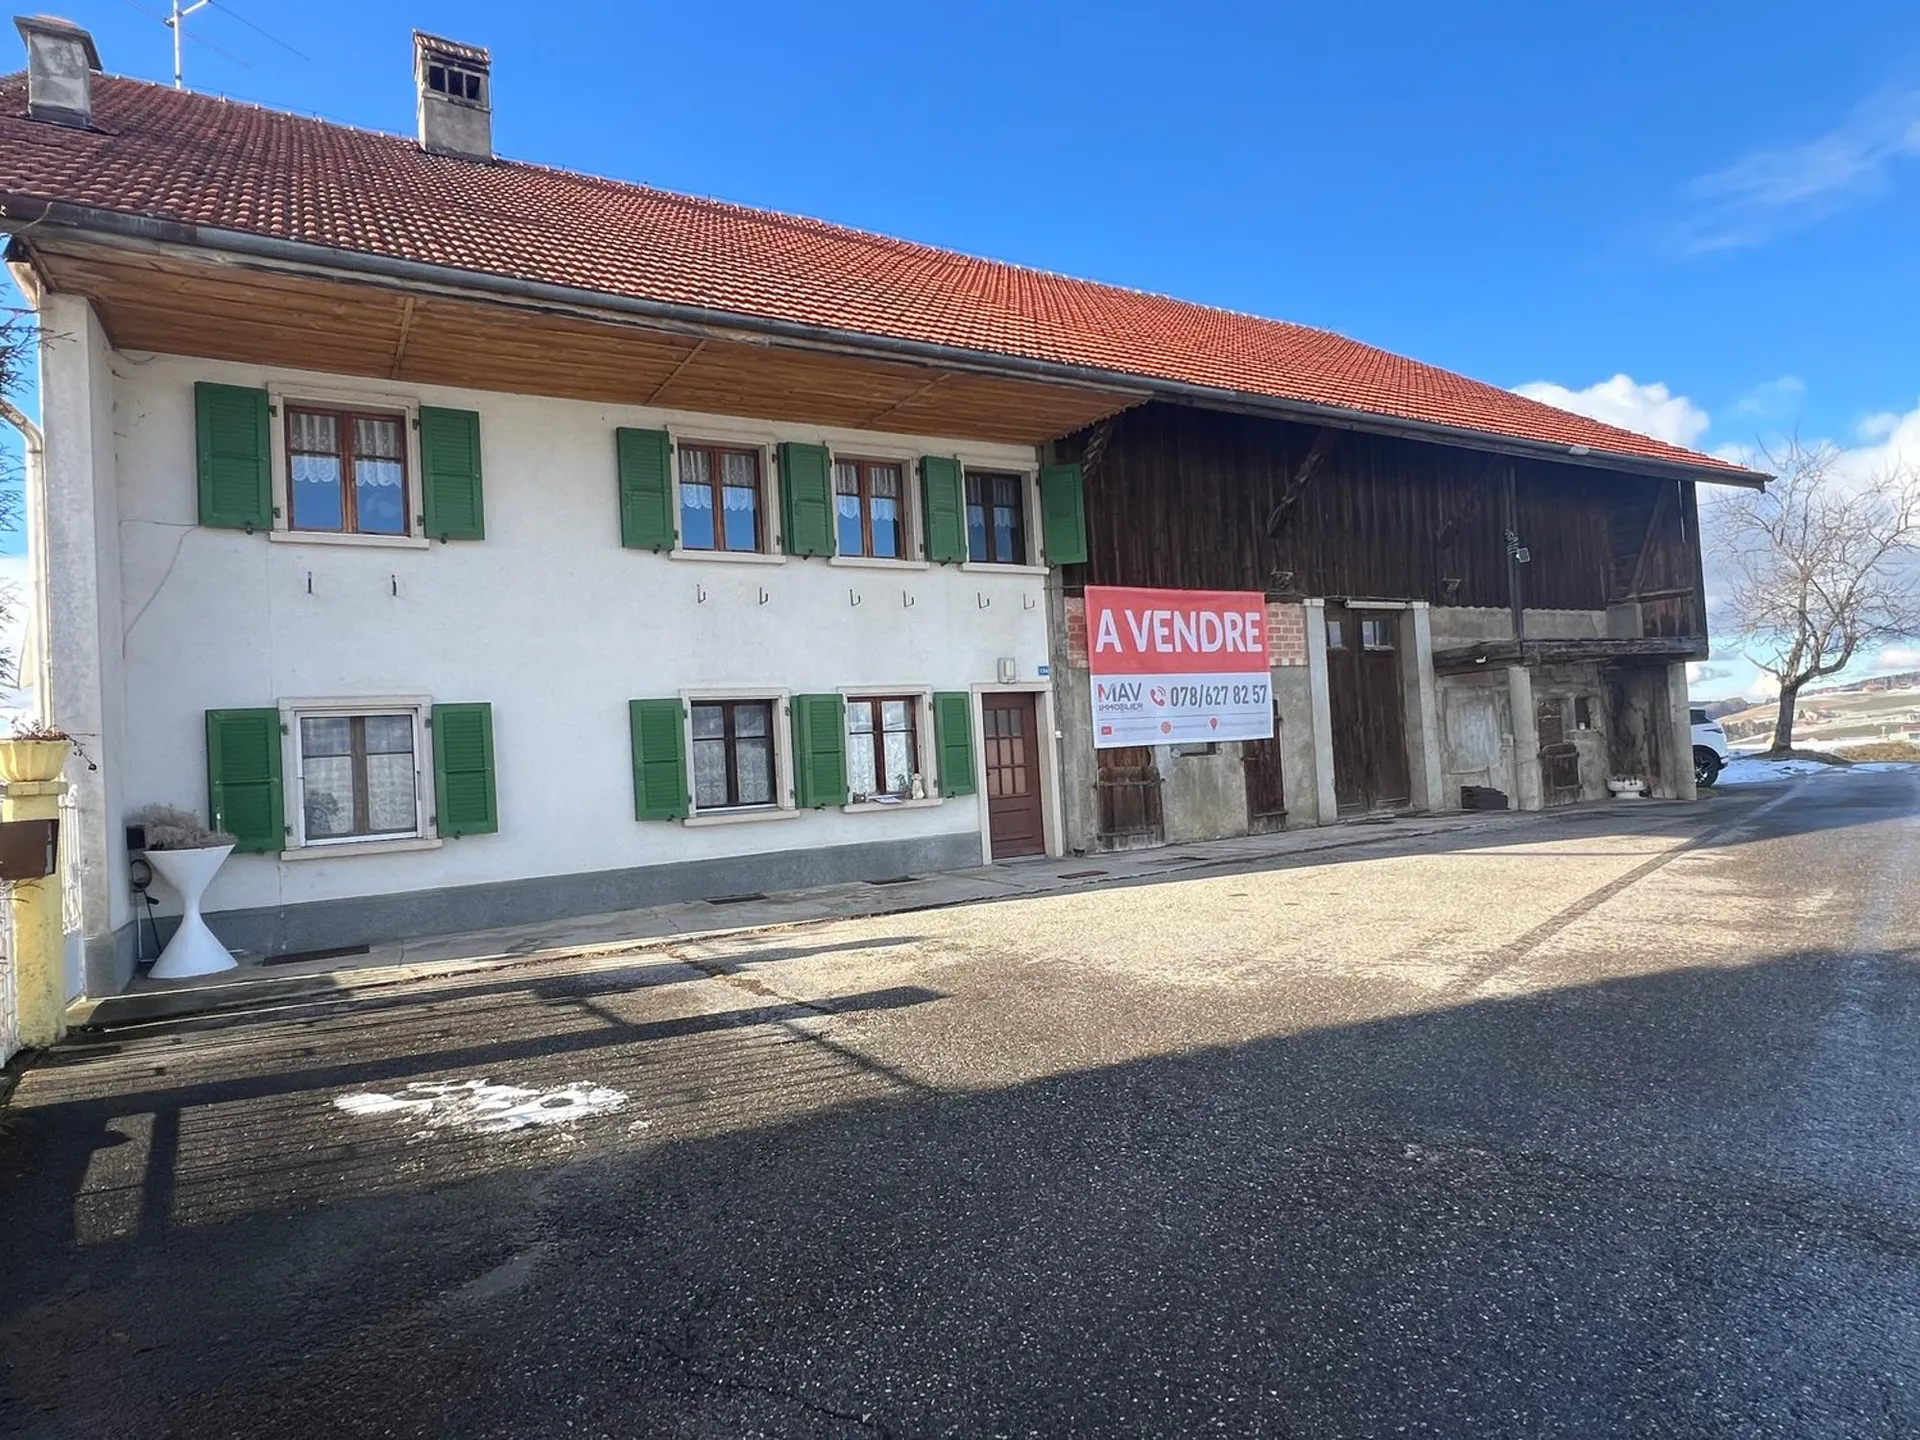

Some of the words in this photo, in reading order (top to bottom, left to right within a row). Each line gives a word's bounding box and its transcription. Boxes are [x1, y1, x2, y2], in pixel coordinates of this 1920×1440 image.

[1095, 608, 1124, 653] A
[1124, 609, 1264, 653] VENDRE
[1098, 682, 1143, 702] MAV
[1170, 684, 1229, 708] 078/627
[1233, 685, 1250, 705] 82
[1252, 684, 1268, 704] 57
